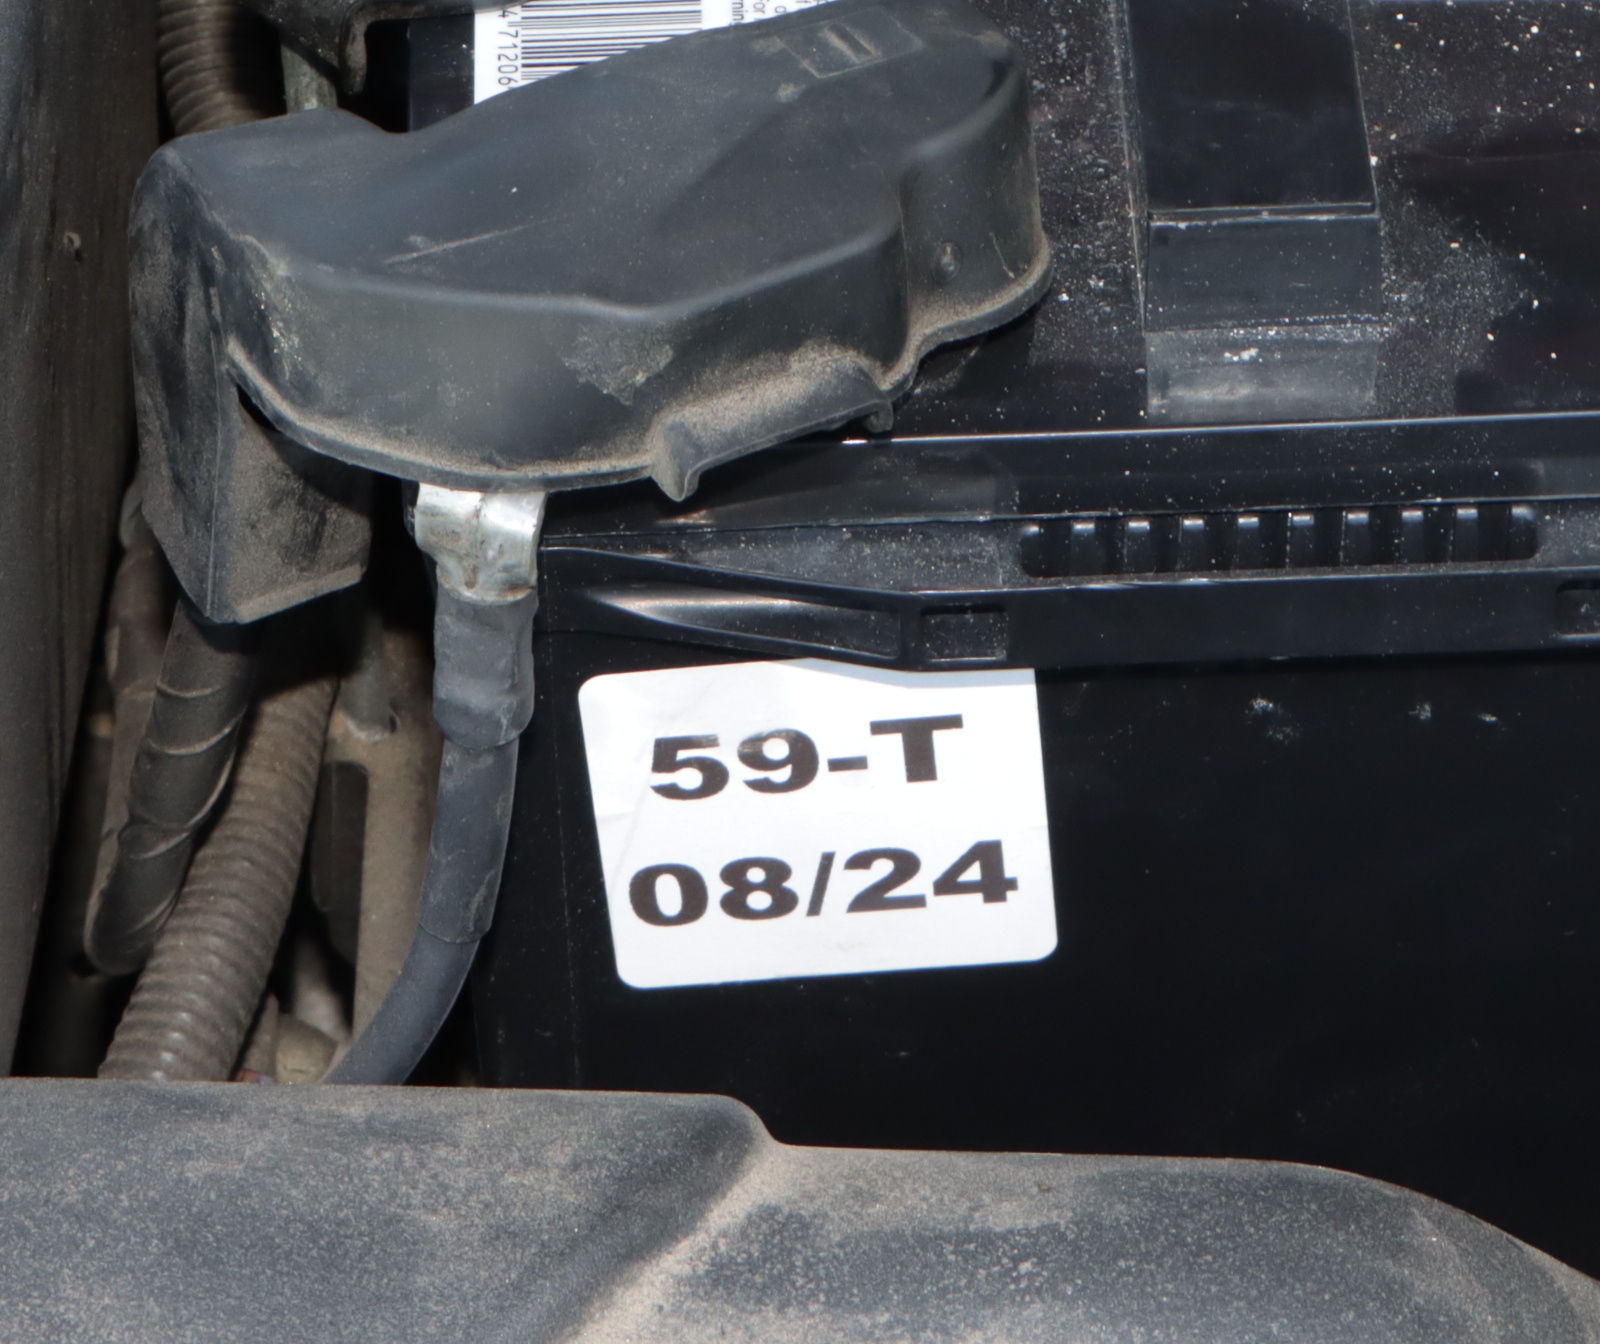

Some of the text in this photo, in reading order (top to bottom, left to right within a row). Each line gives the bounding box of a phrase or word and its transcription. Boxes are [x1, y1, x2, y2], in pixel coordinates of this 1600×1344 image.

[498, 29, 519, 89] 71206
[650, 714, 963, 801] 59-T
[629, 840, 1019, 927] 08/24
